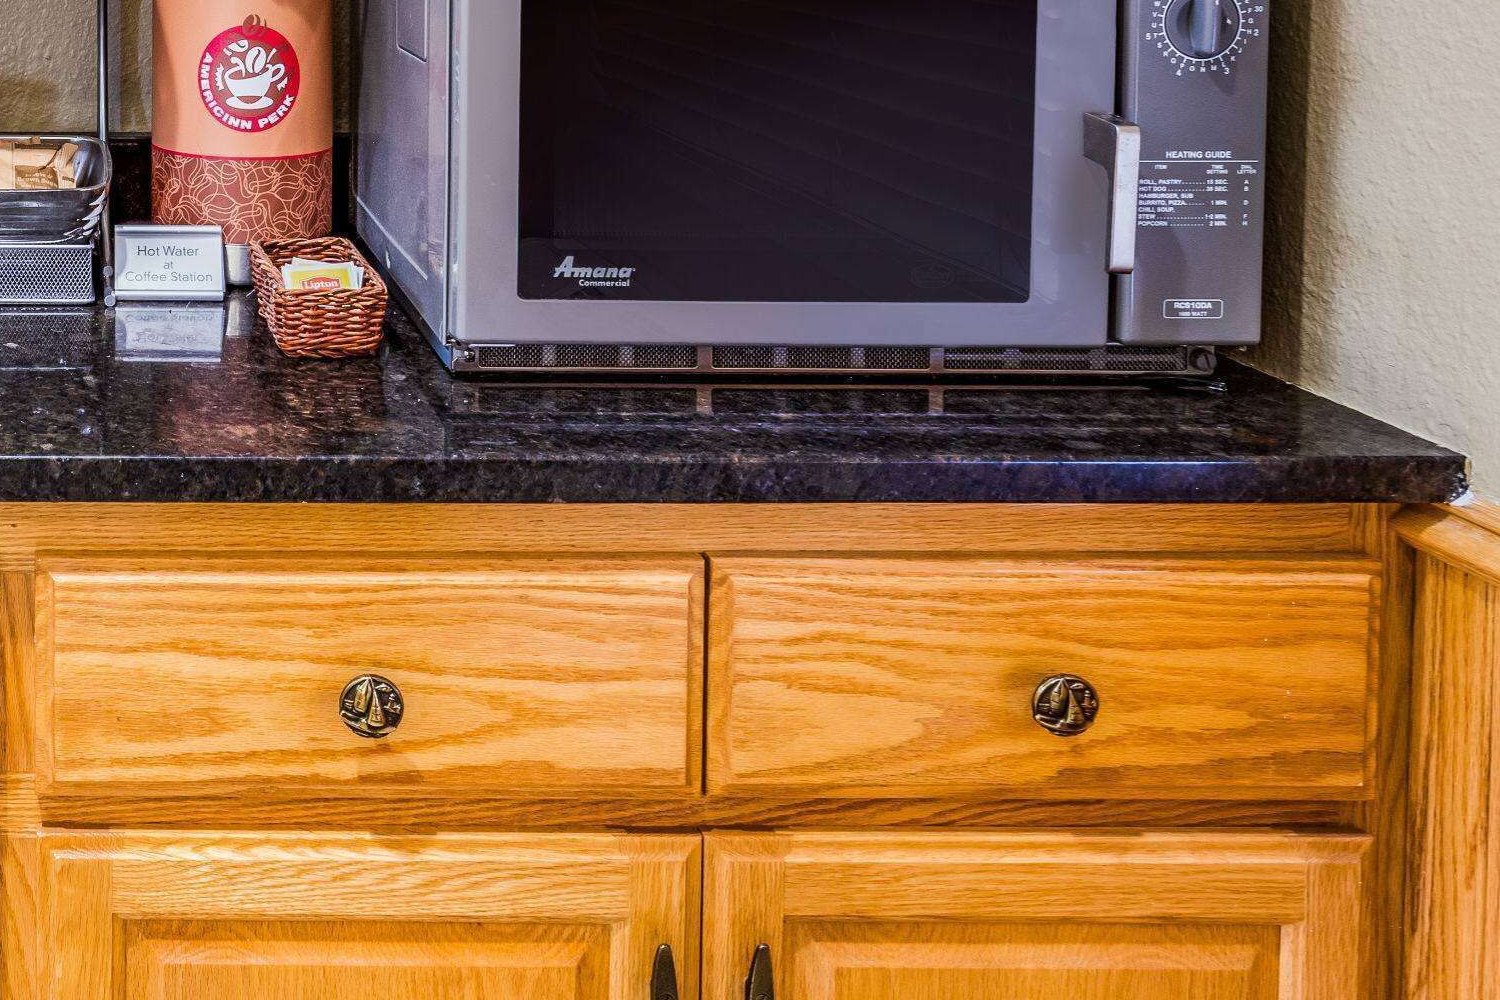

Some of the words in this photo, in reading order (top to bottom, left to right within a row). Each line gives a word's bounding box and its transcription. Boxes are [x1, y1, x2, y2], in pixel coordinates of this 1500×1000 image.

[200, 51, 253, 130] AMERICINN
[257, 94, 295, 129] PERK
[1165, 151, 1204, 159] HEATING
[1204, 151, 1232, 159] GUIDE
[137, 245, 160, 257] Hot
[162, 245, 199, 257] Water
[163, 261, 174, 270] at
[553, 255, 634, 278] Amana
[125, 271, 167, 282] Coffee
[170, 271, 213, 282] Station
[303, 280, 338, 291] Lipton
[578, 278, 630, 287] Commercial
